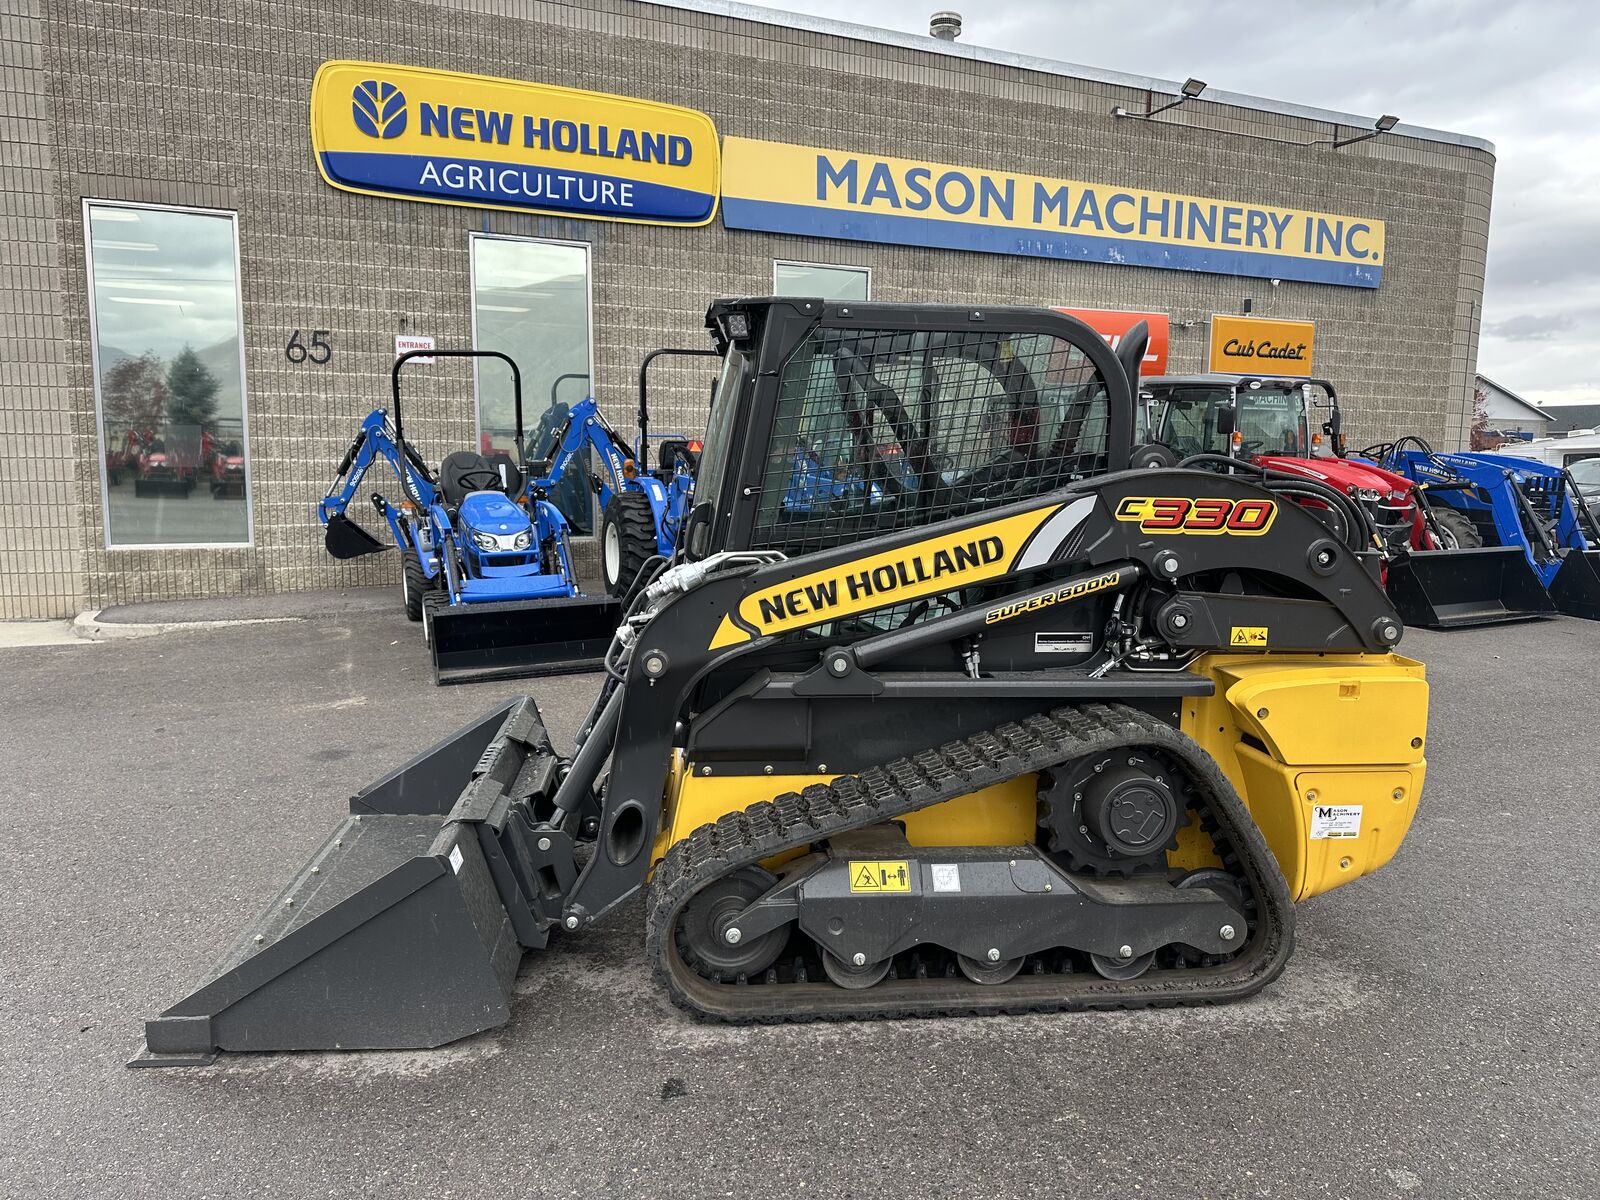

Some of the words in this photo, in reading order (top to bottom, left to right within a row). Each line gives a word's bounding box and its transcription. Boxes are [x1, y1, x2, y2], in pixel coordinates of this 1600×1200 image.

[420, 102, 514, 146] NEW
[523, 115, 693, 168] HOLLAND
[420, 161, 634, 208] AGRICULTURE
[816, 155, 1015, 221] MASON
[1032, 182, 1293, 250] MACHINERY
[1303, 216, 1379, 261] INC.
[286, 330, 331, 364] 65
[398, 341, 431, 350] ENTRANCE
[1223, 339, 1255, 357] Cub
[1256, 341, 1306, 360] Cadet
[611, 453, 621, 470] NEW
[616, 470, 627, 493] HOLLA
[1116, 497, 1277, 534] C330
[758, 579, 838, 625] NEW
[846, 535, 1005, 601] HOLLAND
[987, 593, 1056, 623] SUPER
[1058, 572, 1119, 602] BOOM
